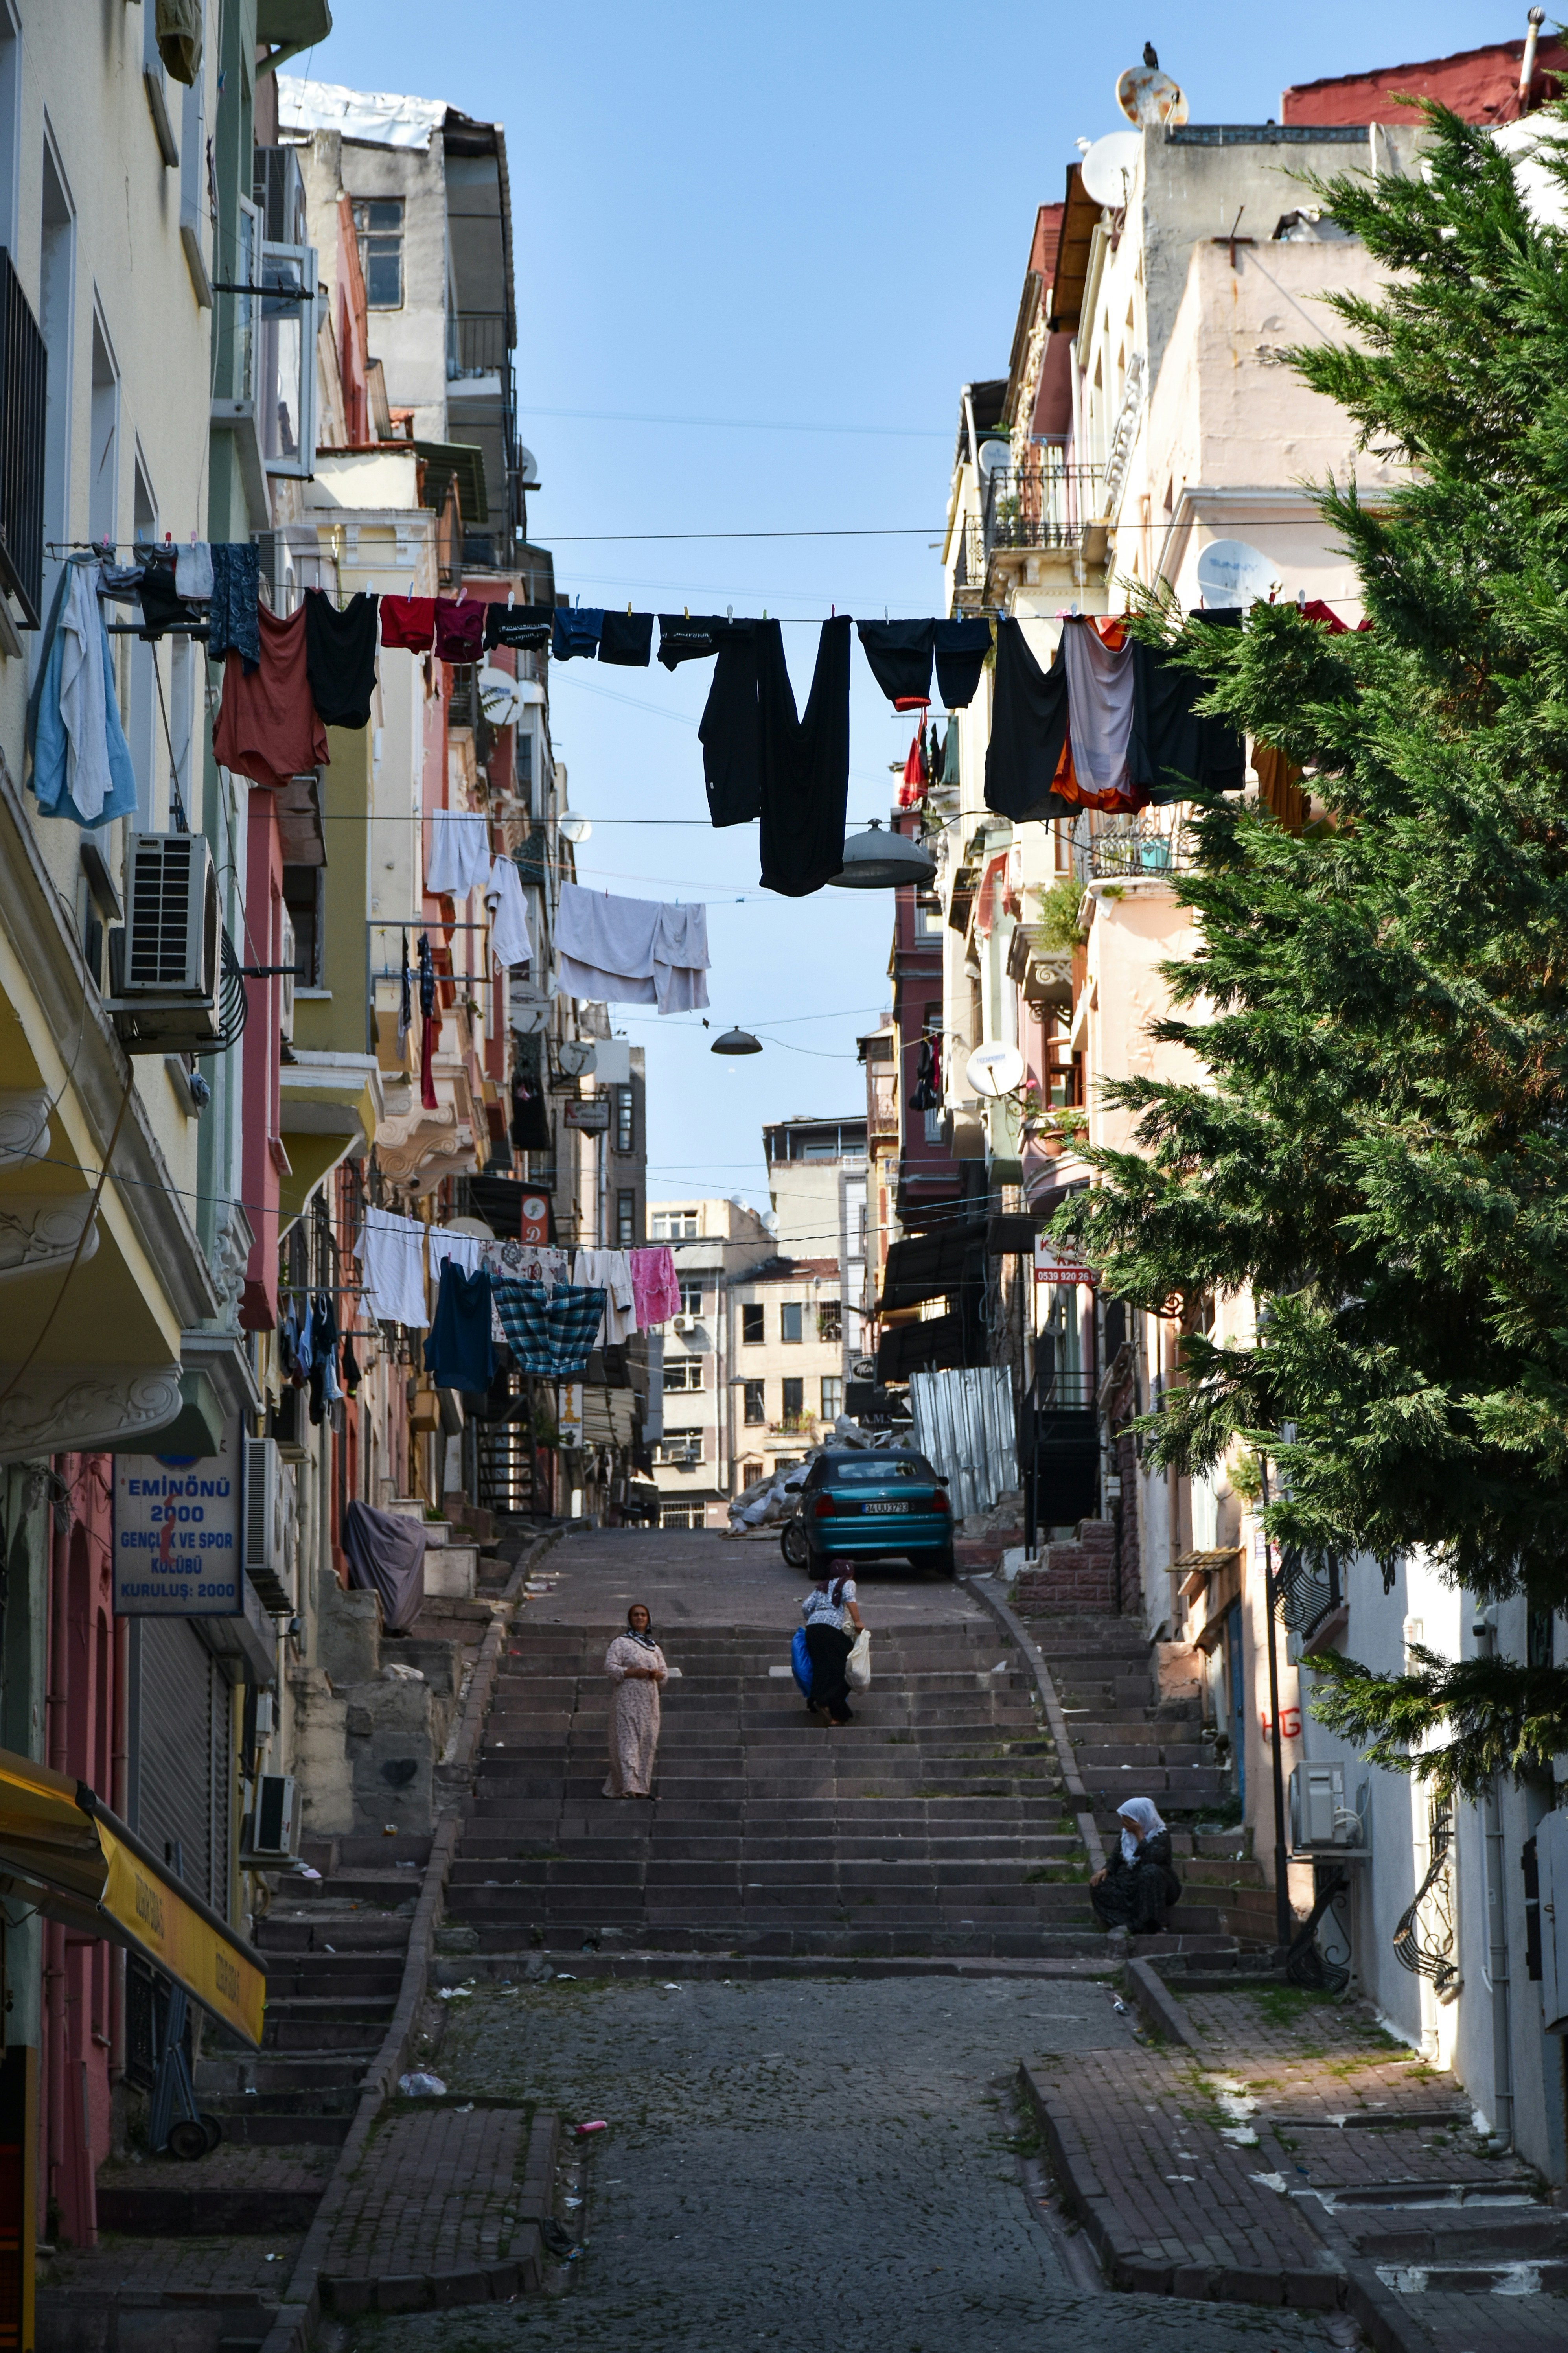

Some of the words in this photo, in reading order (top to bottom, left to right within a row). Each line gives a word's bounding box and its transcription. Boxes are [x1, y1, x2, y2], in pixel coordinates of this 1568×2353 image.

[1038, 1272, 1058, 1281] 0539
[1061, 1272, 1076, 1281] 920
[129, 1475, 230, 1497] EMİNÖNÜ
[151, 1505, 204, 1523] 2000
[121, 1532, 176, 1553] GENÇLK
[180, 1533, 196, 1548] VE
[199, 1533, 233, 1548] SPOR
[198, 1583, 235, 1598] 2000
